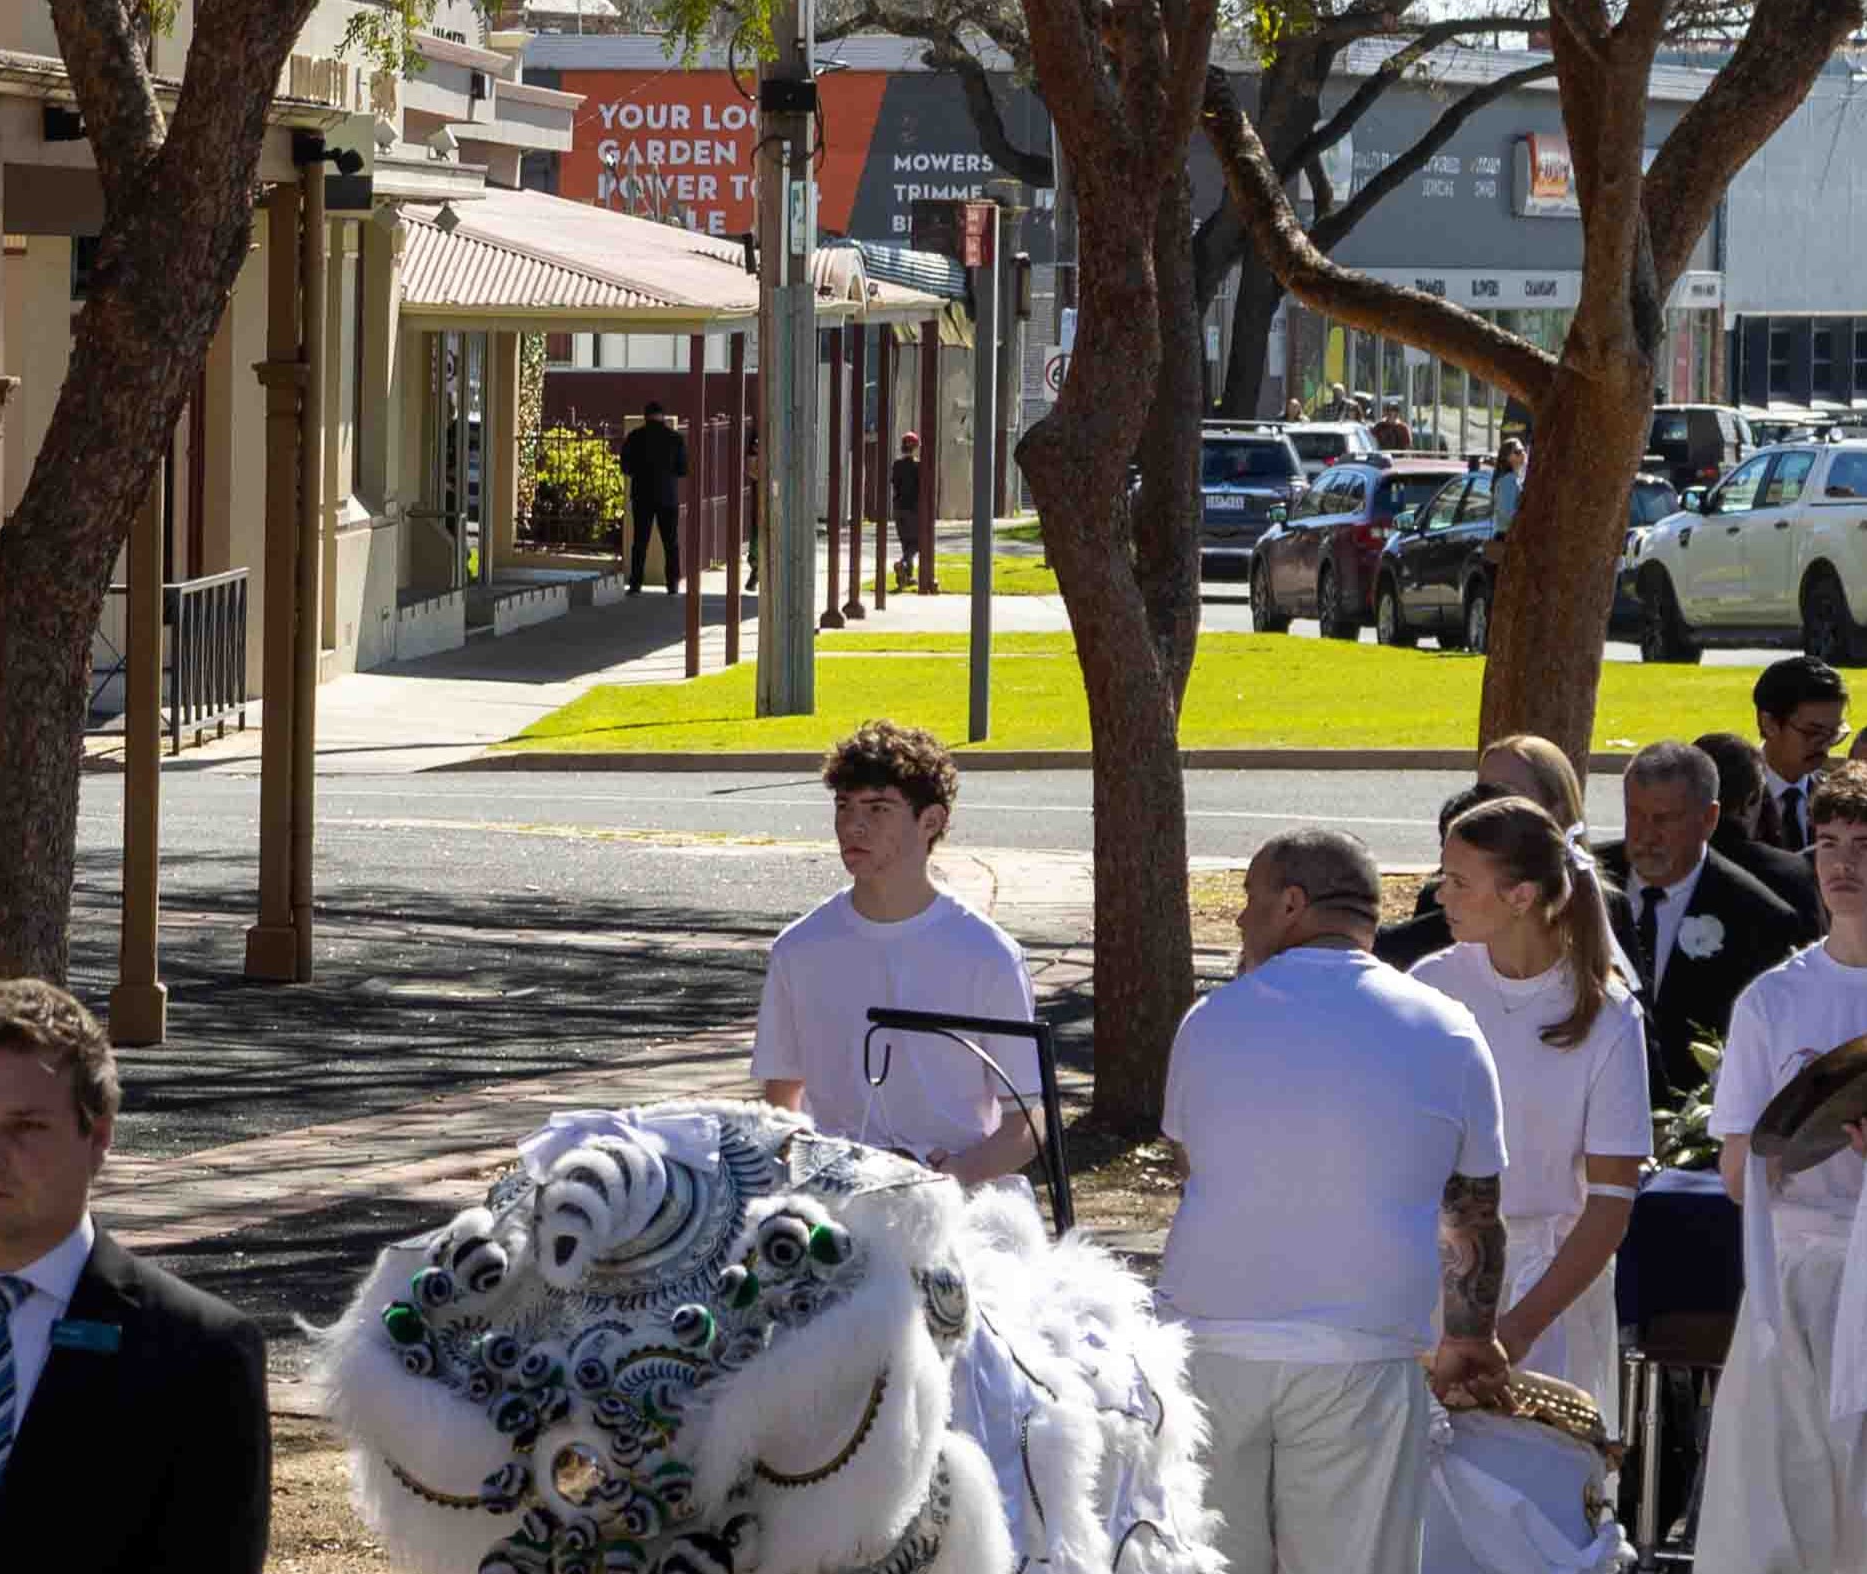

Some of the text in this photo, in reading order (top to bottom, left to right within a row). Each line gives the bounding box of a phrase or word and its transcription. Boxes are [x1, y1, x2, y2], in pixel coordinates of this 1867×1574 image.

[597, 103, 691, 130] YOUR
[597, 139, 737, 166] GARDEN
[893, 153, 995, 173] MOWERS
[597, 173, 719, 201] POWER
